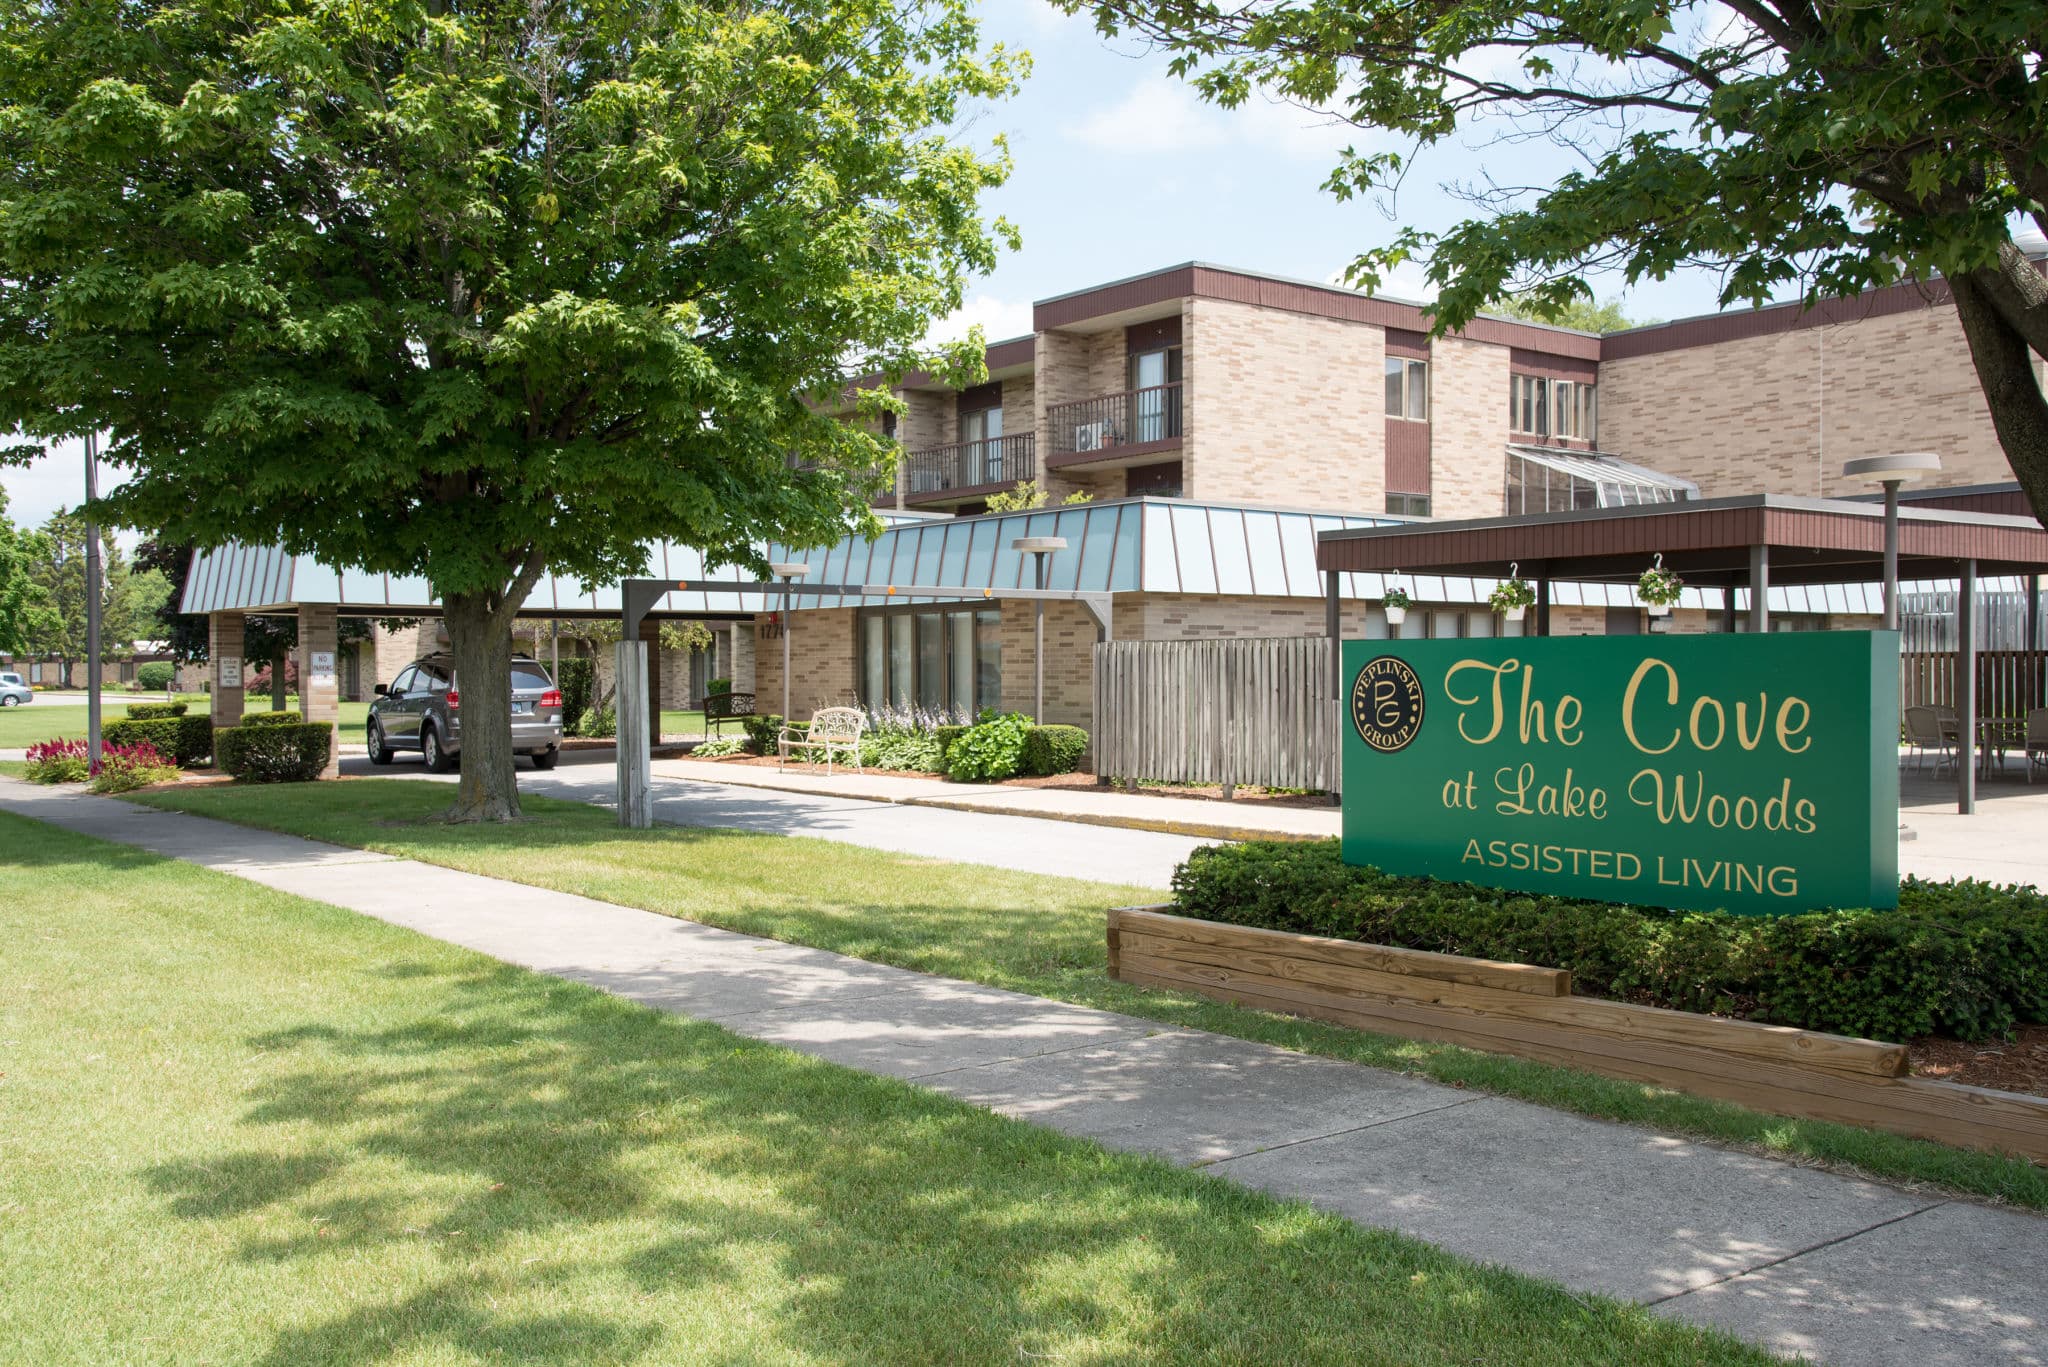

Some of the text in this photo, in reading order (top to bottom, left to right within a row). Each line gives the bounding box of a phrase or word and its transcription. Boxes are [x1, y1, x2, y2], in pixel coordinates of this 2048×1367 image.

[318, 655, 328, 663] NO
[1357, 661, 1419, 701] PEPLINSKI
[1444, 658, 1812, 755] The Cove
[1363, 723, 1409, 747] GROUP
[1442, 762, 1816, 834] at Lake Woods
[1461, 838, 1798, 897] ASSISTED LIVING
